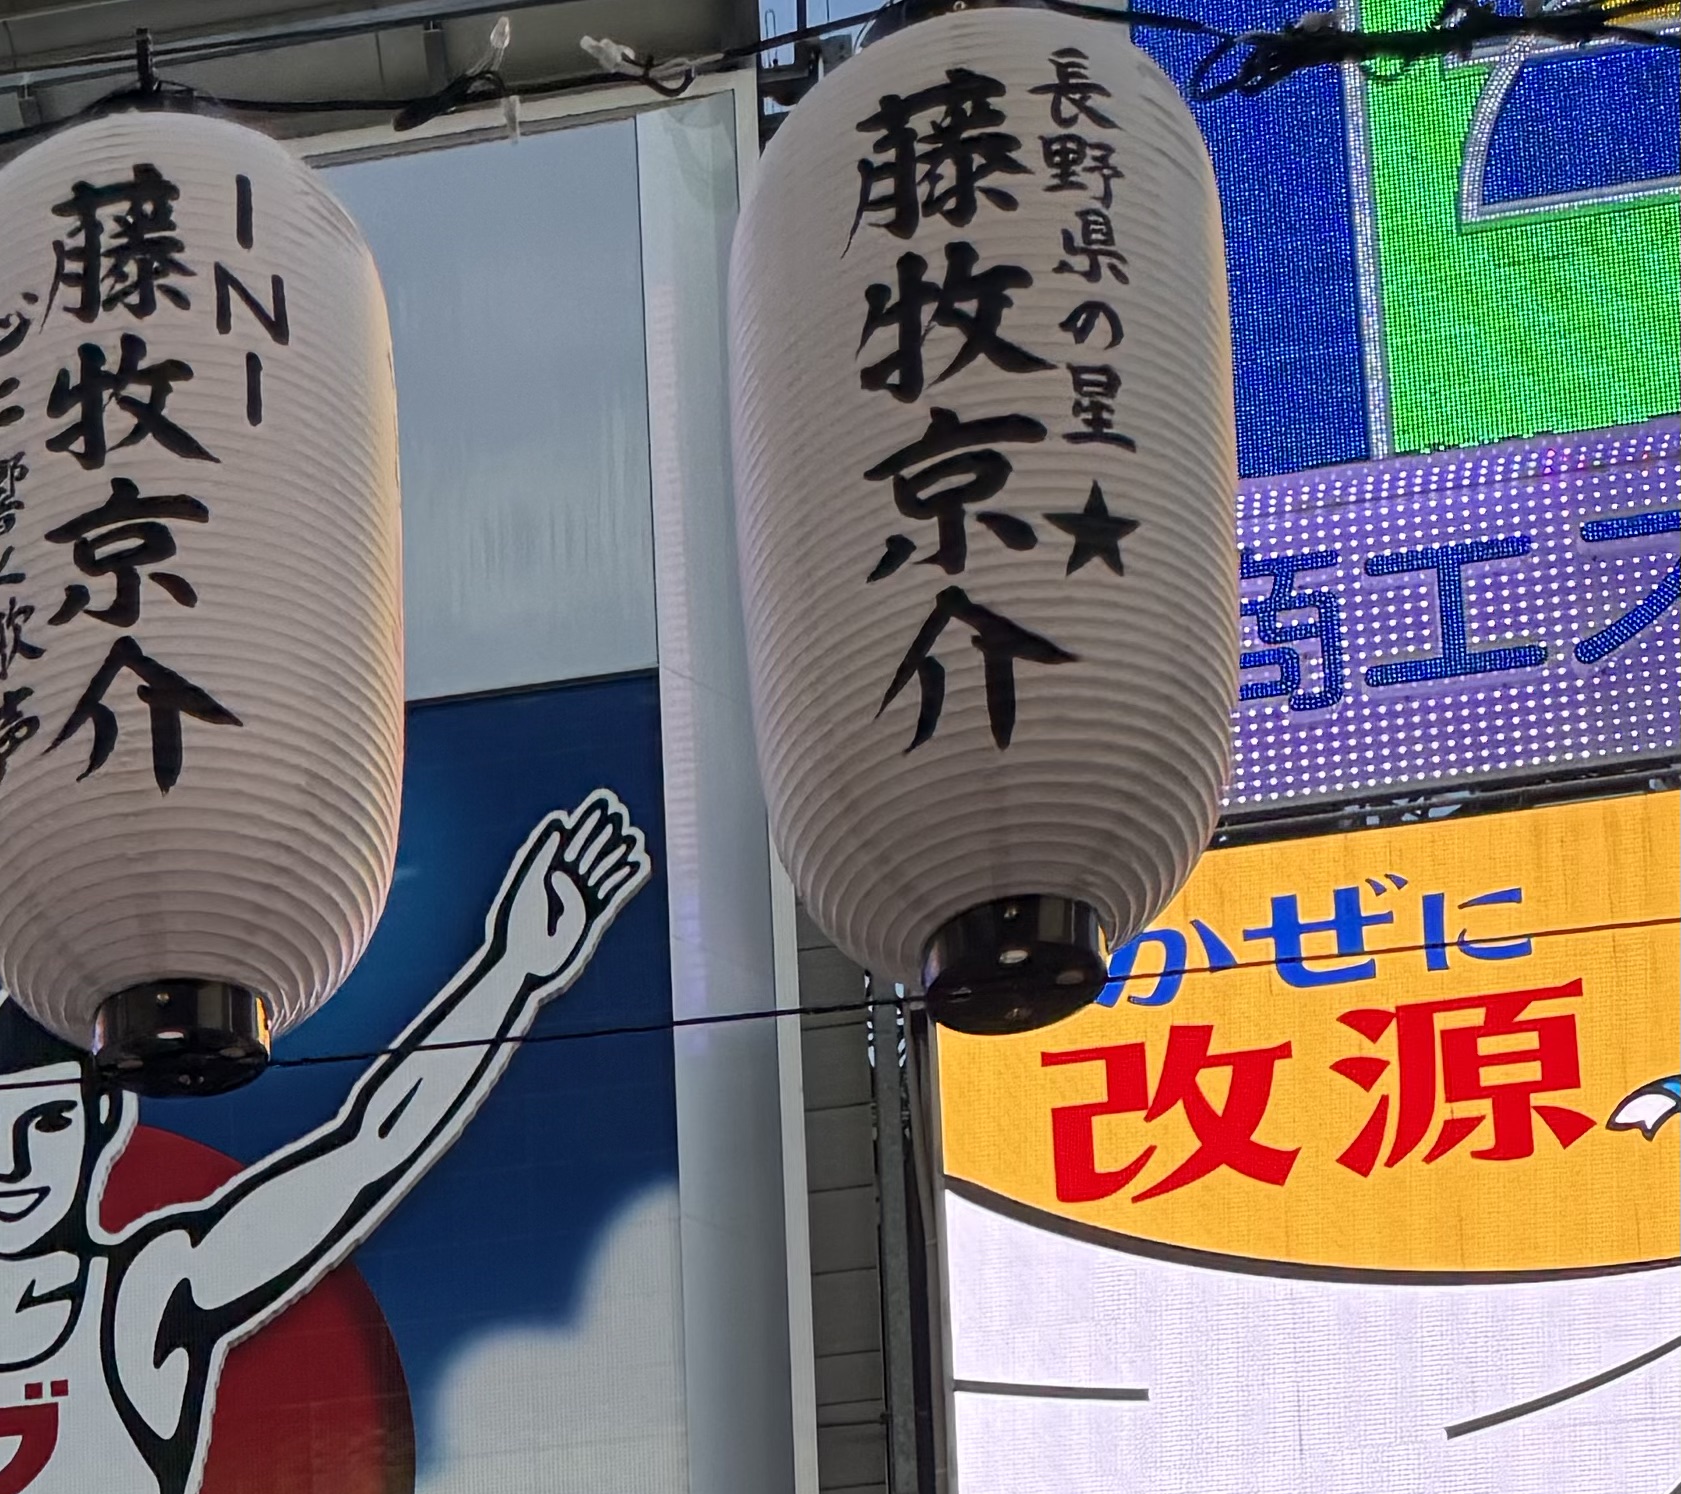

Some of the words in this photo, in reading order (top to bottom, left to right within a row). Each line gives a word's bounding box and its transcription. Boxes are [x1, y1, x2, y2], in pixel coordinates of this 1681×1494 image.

[213, 172, 290, 426] INI
[841, 67, 1080, 756] 藤牧京介
[41, 162, 244, 797] 藤牧京介
[1096, 872, 1534, 1007] かぜに
[1039, 976, 1598, 1205] 改源
